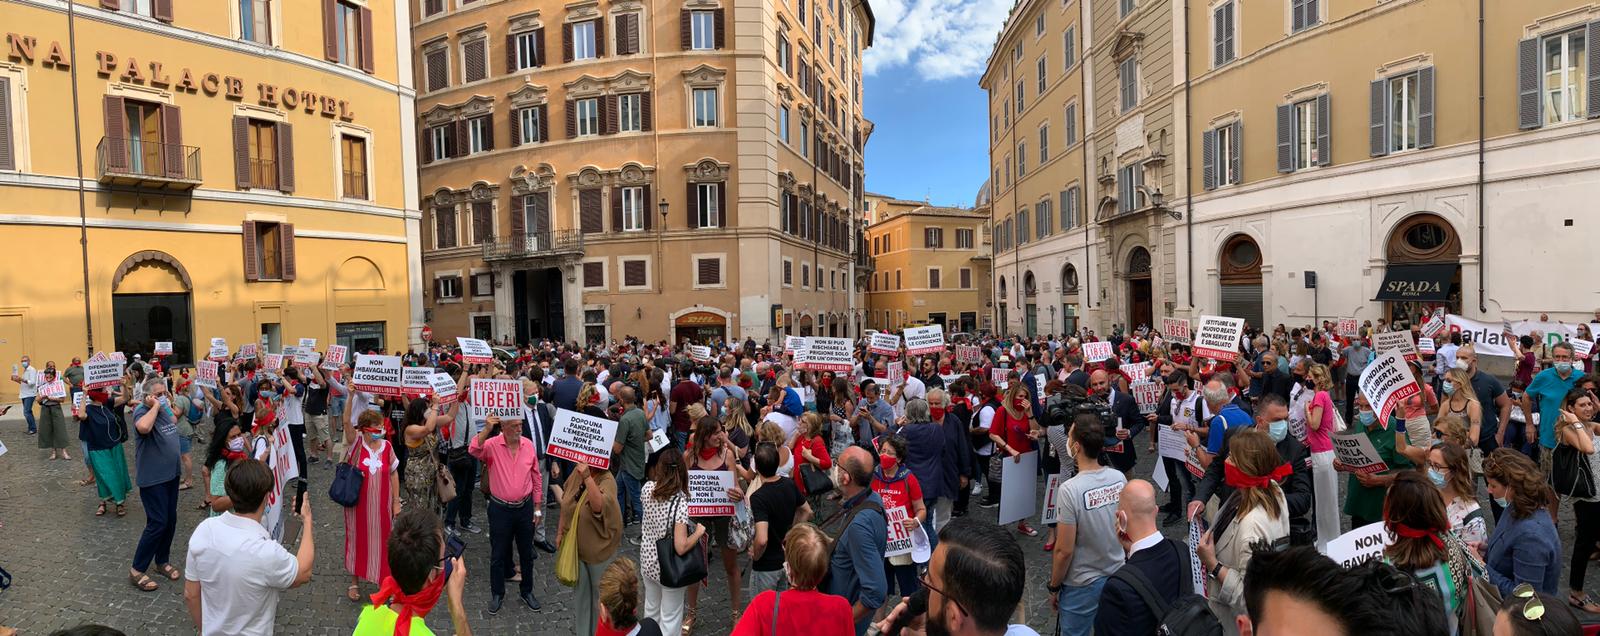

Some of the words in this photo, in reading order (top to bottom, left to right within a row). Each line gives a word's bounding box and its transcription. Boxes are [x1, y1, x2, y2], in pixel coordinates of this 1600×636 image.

[7, 32, 70, 71] NA
[97, 51, 244, 100] PALACE
[258, 82, 355, 122] HOTEL
[1386, 280, 1440, 292] SPADA
[1164, 325, 1188, 337] LIBERI
[356, 366, 399, 375] IMBAVAGLIATE
[362, 374, 398, 382] COSCIENZE
[1371, 366, 1397, 392] LIBERTÀ
[474, 382, 520, 391] #RESTIAMO
[1376, 374, 1405, 402] OPINIONE
[474, 391, 520, 408] LIBERI
[1136, 392, 1159, 404] LIBE
[475, 407, 481, 415] DI
[485, 408, 520, 416] PENSARE
[570, 423, 600, 434] PANDEMIA
[571, 416, 588, 426] DOPO
[589, 421, 602, 429] UNA
[563, 427, 604, 442] L'EMERGENZA
[553, 437, 609, 455] L'OMOTRANSFOBIA
[1351, 448, 1363, 456] LA
[1355, 533, 1383, 550] NON
